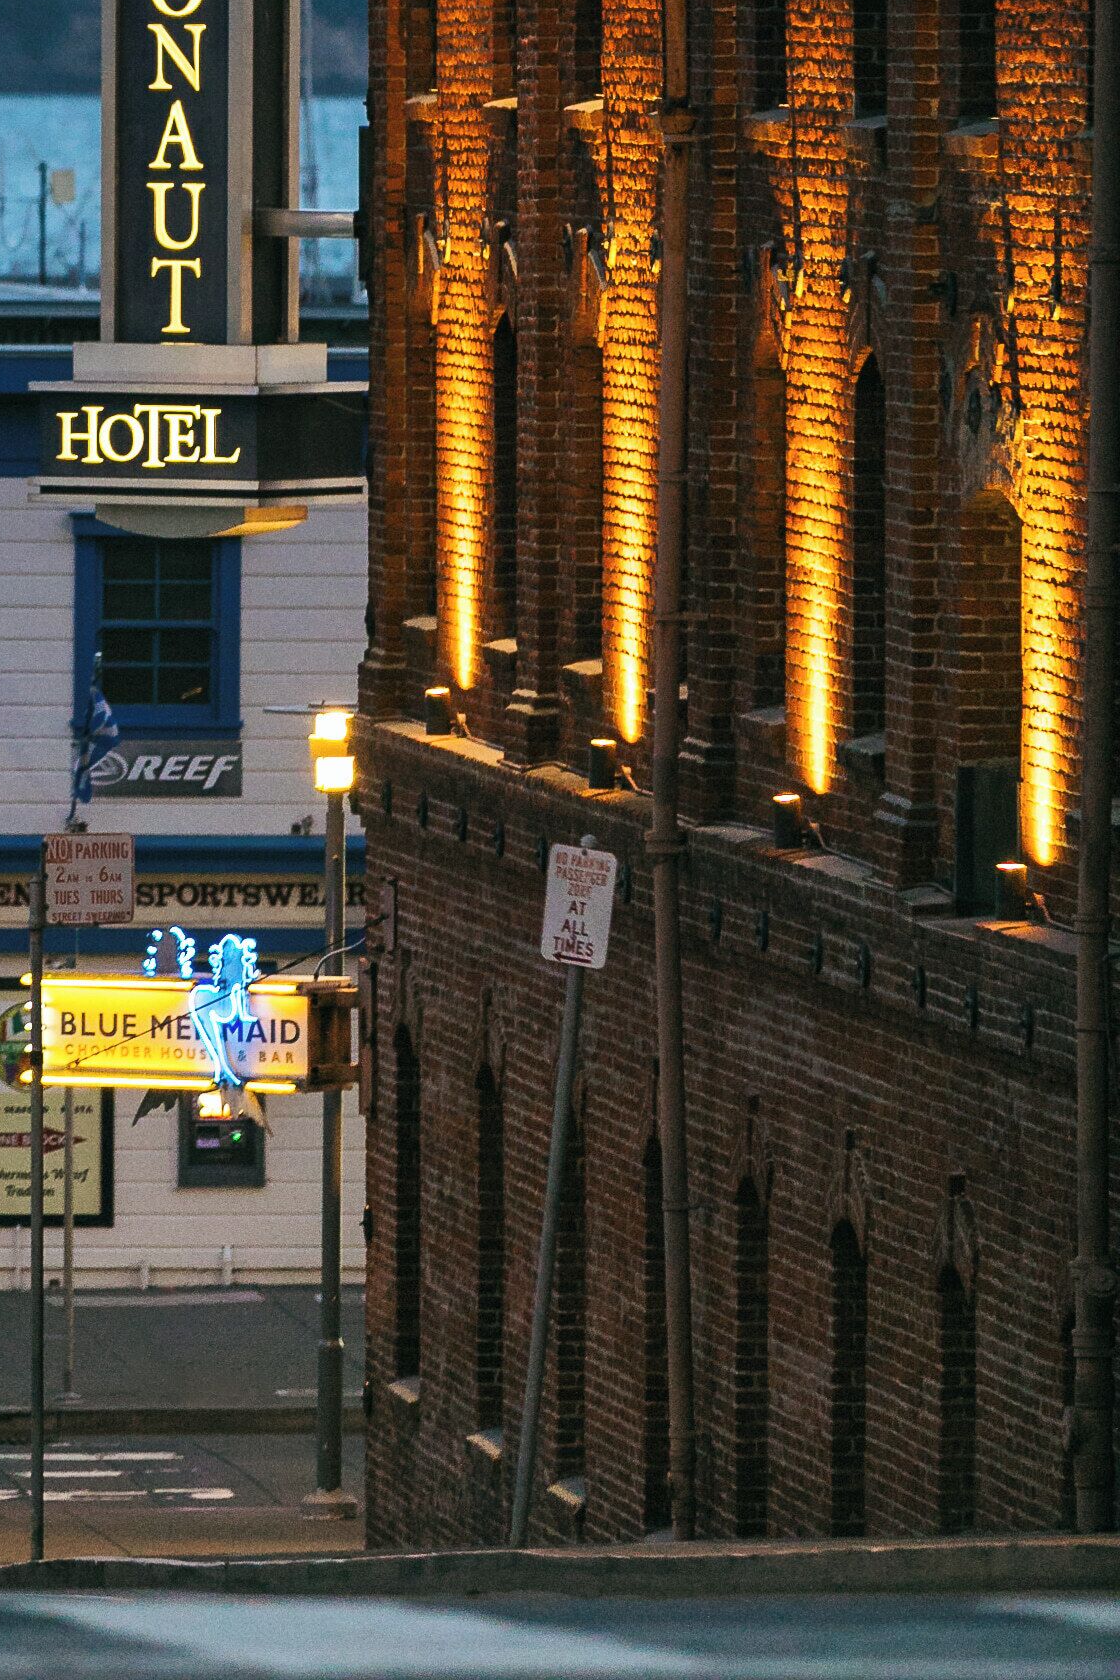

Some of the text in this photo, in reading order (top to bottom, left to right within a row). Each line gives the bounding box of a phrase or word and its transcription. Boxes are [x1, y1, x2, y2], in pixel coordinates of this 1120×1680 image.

[55, 403, 241, 468] HOTEL
[127, 755, 239, 790] REEF
[47, 838, 129, 861] NO PARKING
[54, 889, 124, 905] TUES THURS
[136, 881, 368, 907] SPORTSWER
[51, 910, 126, 922] STREET SWEEPING
[568, 901, 587, 916] AT
[561, 919, 589, 937] ALL
[553, 936, 594, 958] TIMES
[60, 1010, 301, 1045] BLUE MEMAID
[65, 1043, 152, 1059] CHOWDER
[161, 1047, 212, 1062] HOUS
[258, 1050, 295, 1064] BAR
